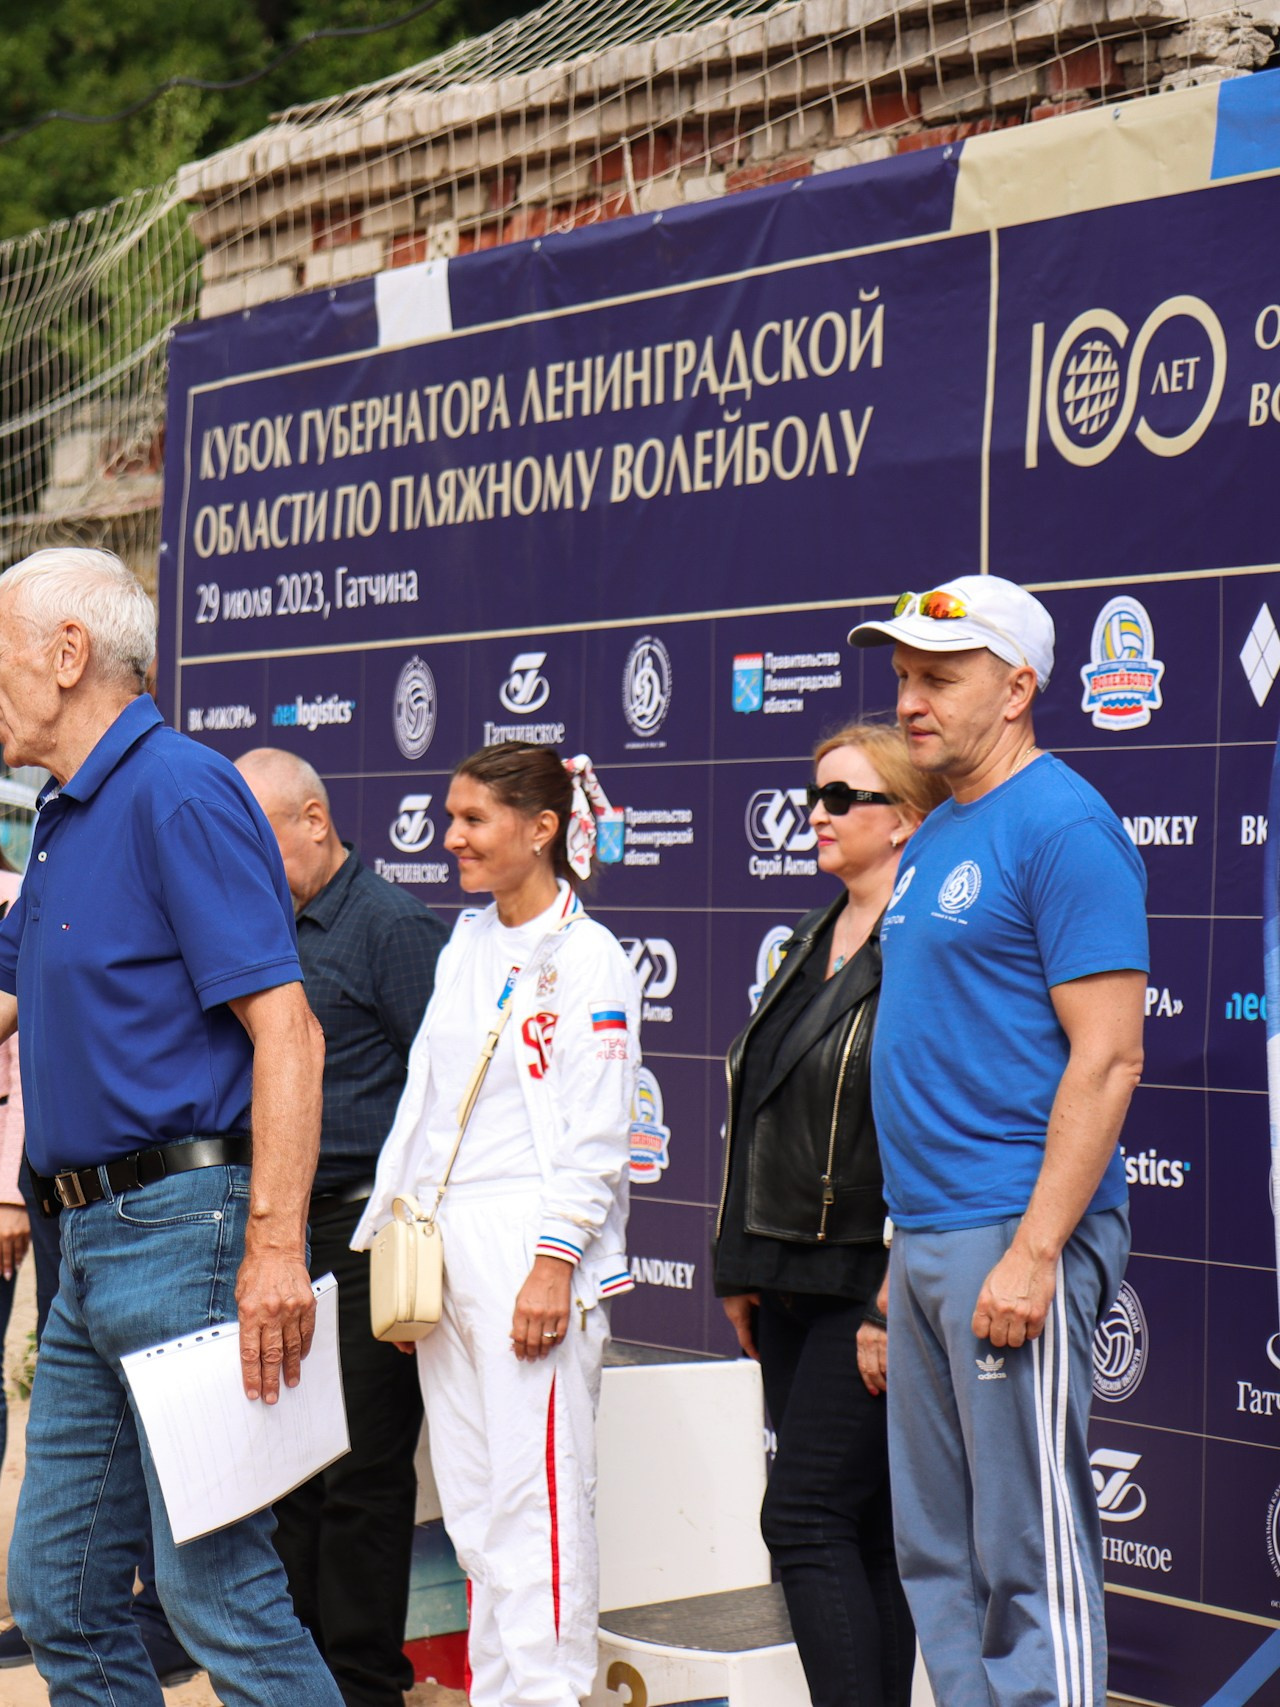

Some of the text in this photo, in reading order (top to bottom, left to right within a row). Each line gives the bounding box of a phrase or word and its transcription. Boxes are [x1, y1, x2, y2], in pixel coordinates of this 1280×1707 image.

[199, 286, 886, 480] КУБОК ГУБЕРНАТОРА ЛЕНИНГРАДСКОЙ
[1150, 357, 1201, 396] ЛЕТ
[194, 406, 874, 559] ОБЛАСТИ ПО ПЛЯЖНОМУ ВОЛЕЙБОЛУ
[195, 567, 419, 624] 29 июля 2023, Гатчина
[1122, 815, 1198, 846] NDKEY
[749, 855, 819, 881] Строй Актив
[629, 1256, 696, 1290] ANDKEY
[1102, 1536, 1173, 1572] инское
